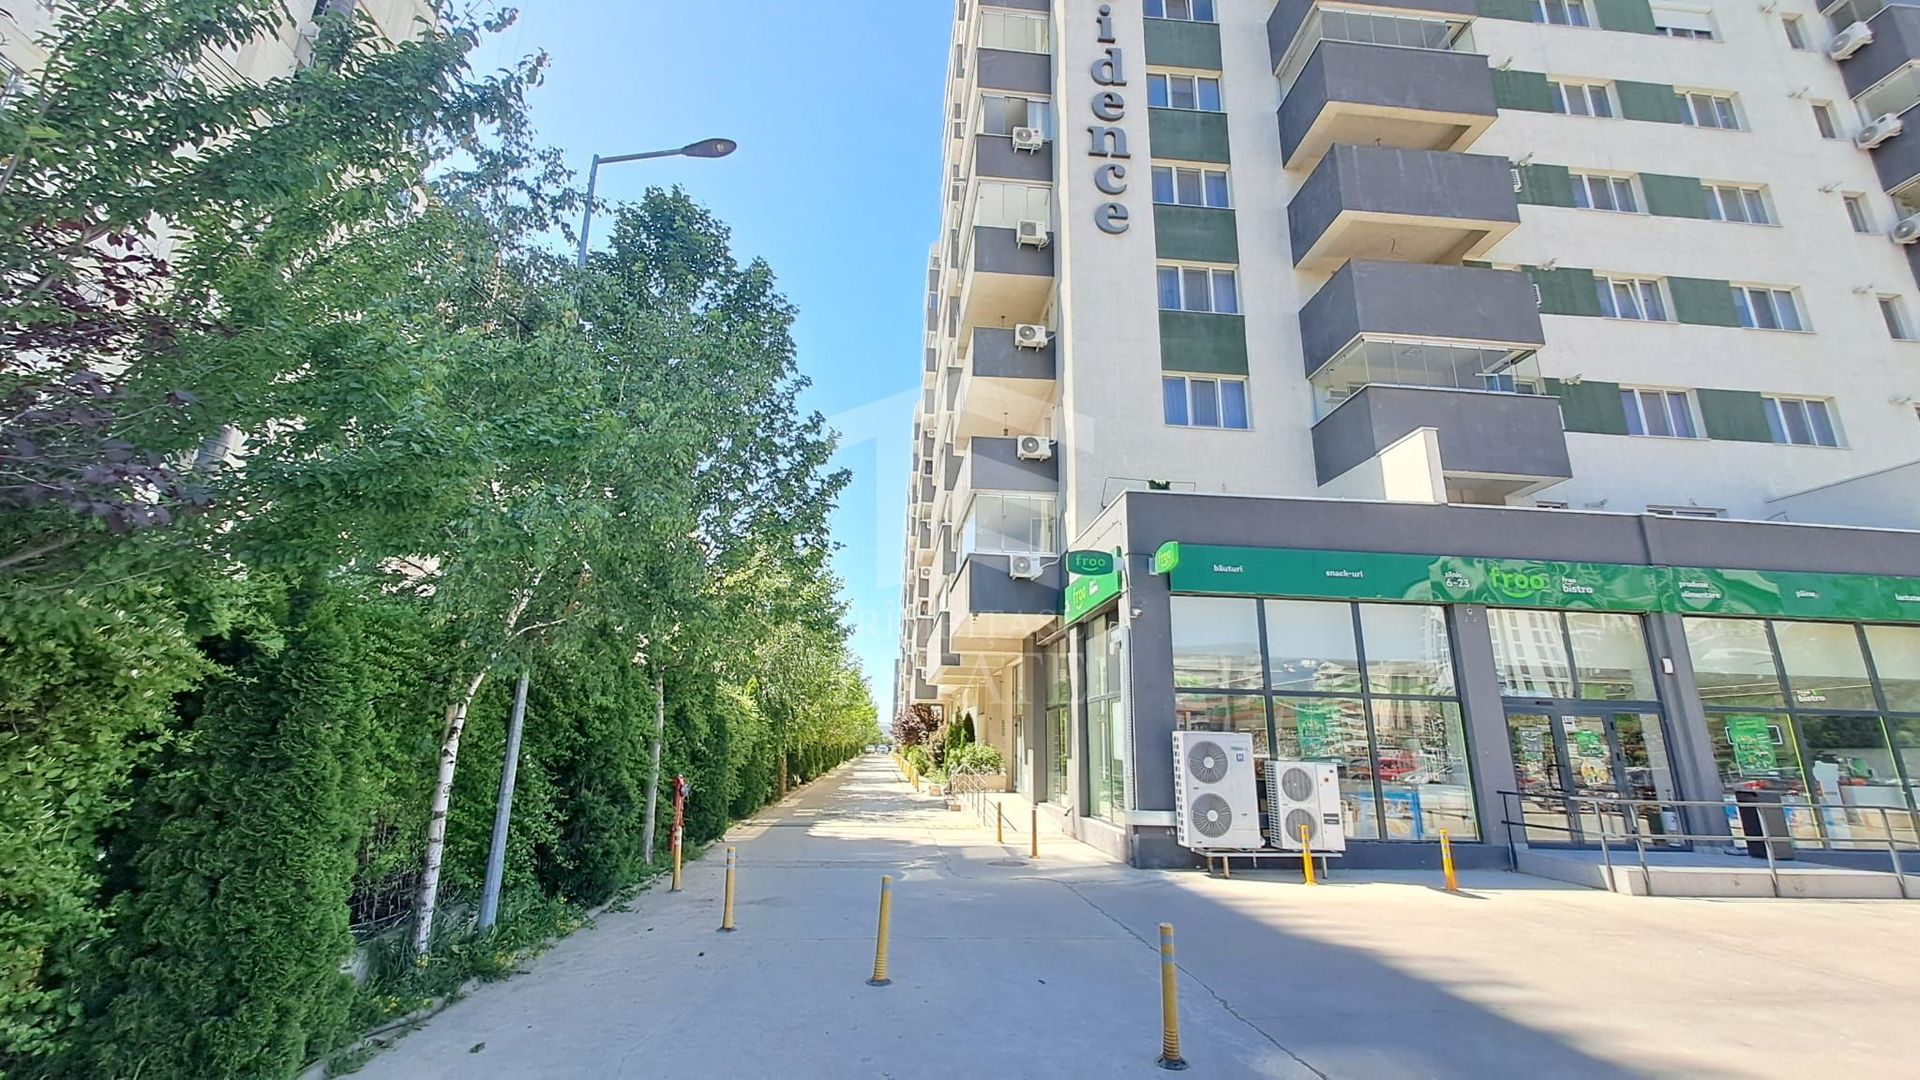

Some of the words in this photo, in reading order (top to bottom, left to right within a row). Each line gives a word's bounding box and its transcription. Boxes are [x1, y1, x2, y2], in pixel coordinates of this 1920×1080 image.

[1087, 4, 1131, 234] idence
[1075, 554, 1106, 567] froo
[1213, 563, 1243, 573] băuturi
[1325, 569, 1364, 578] snack-uri
[1489, 566, 1545, 591] froo
[1446, 578, 1470, 588] 6-23
[1562, 584, 1593, 594] bistro
